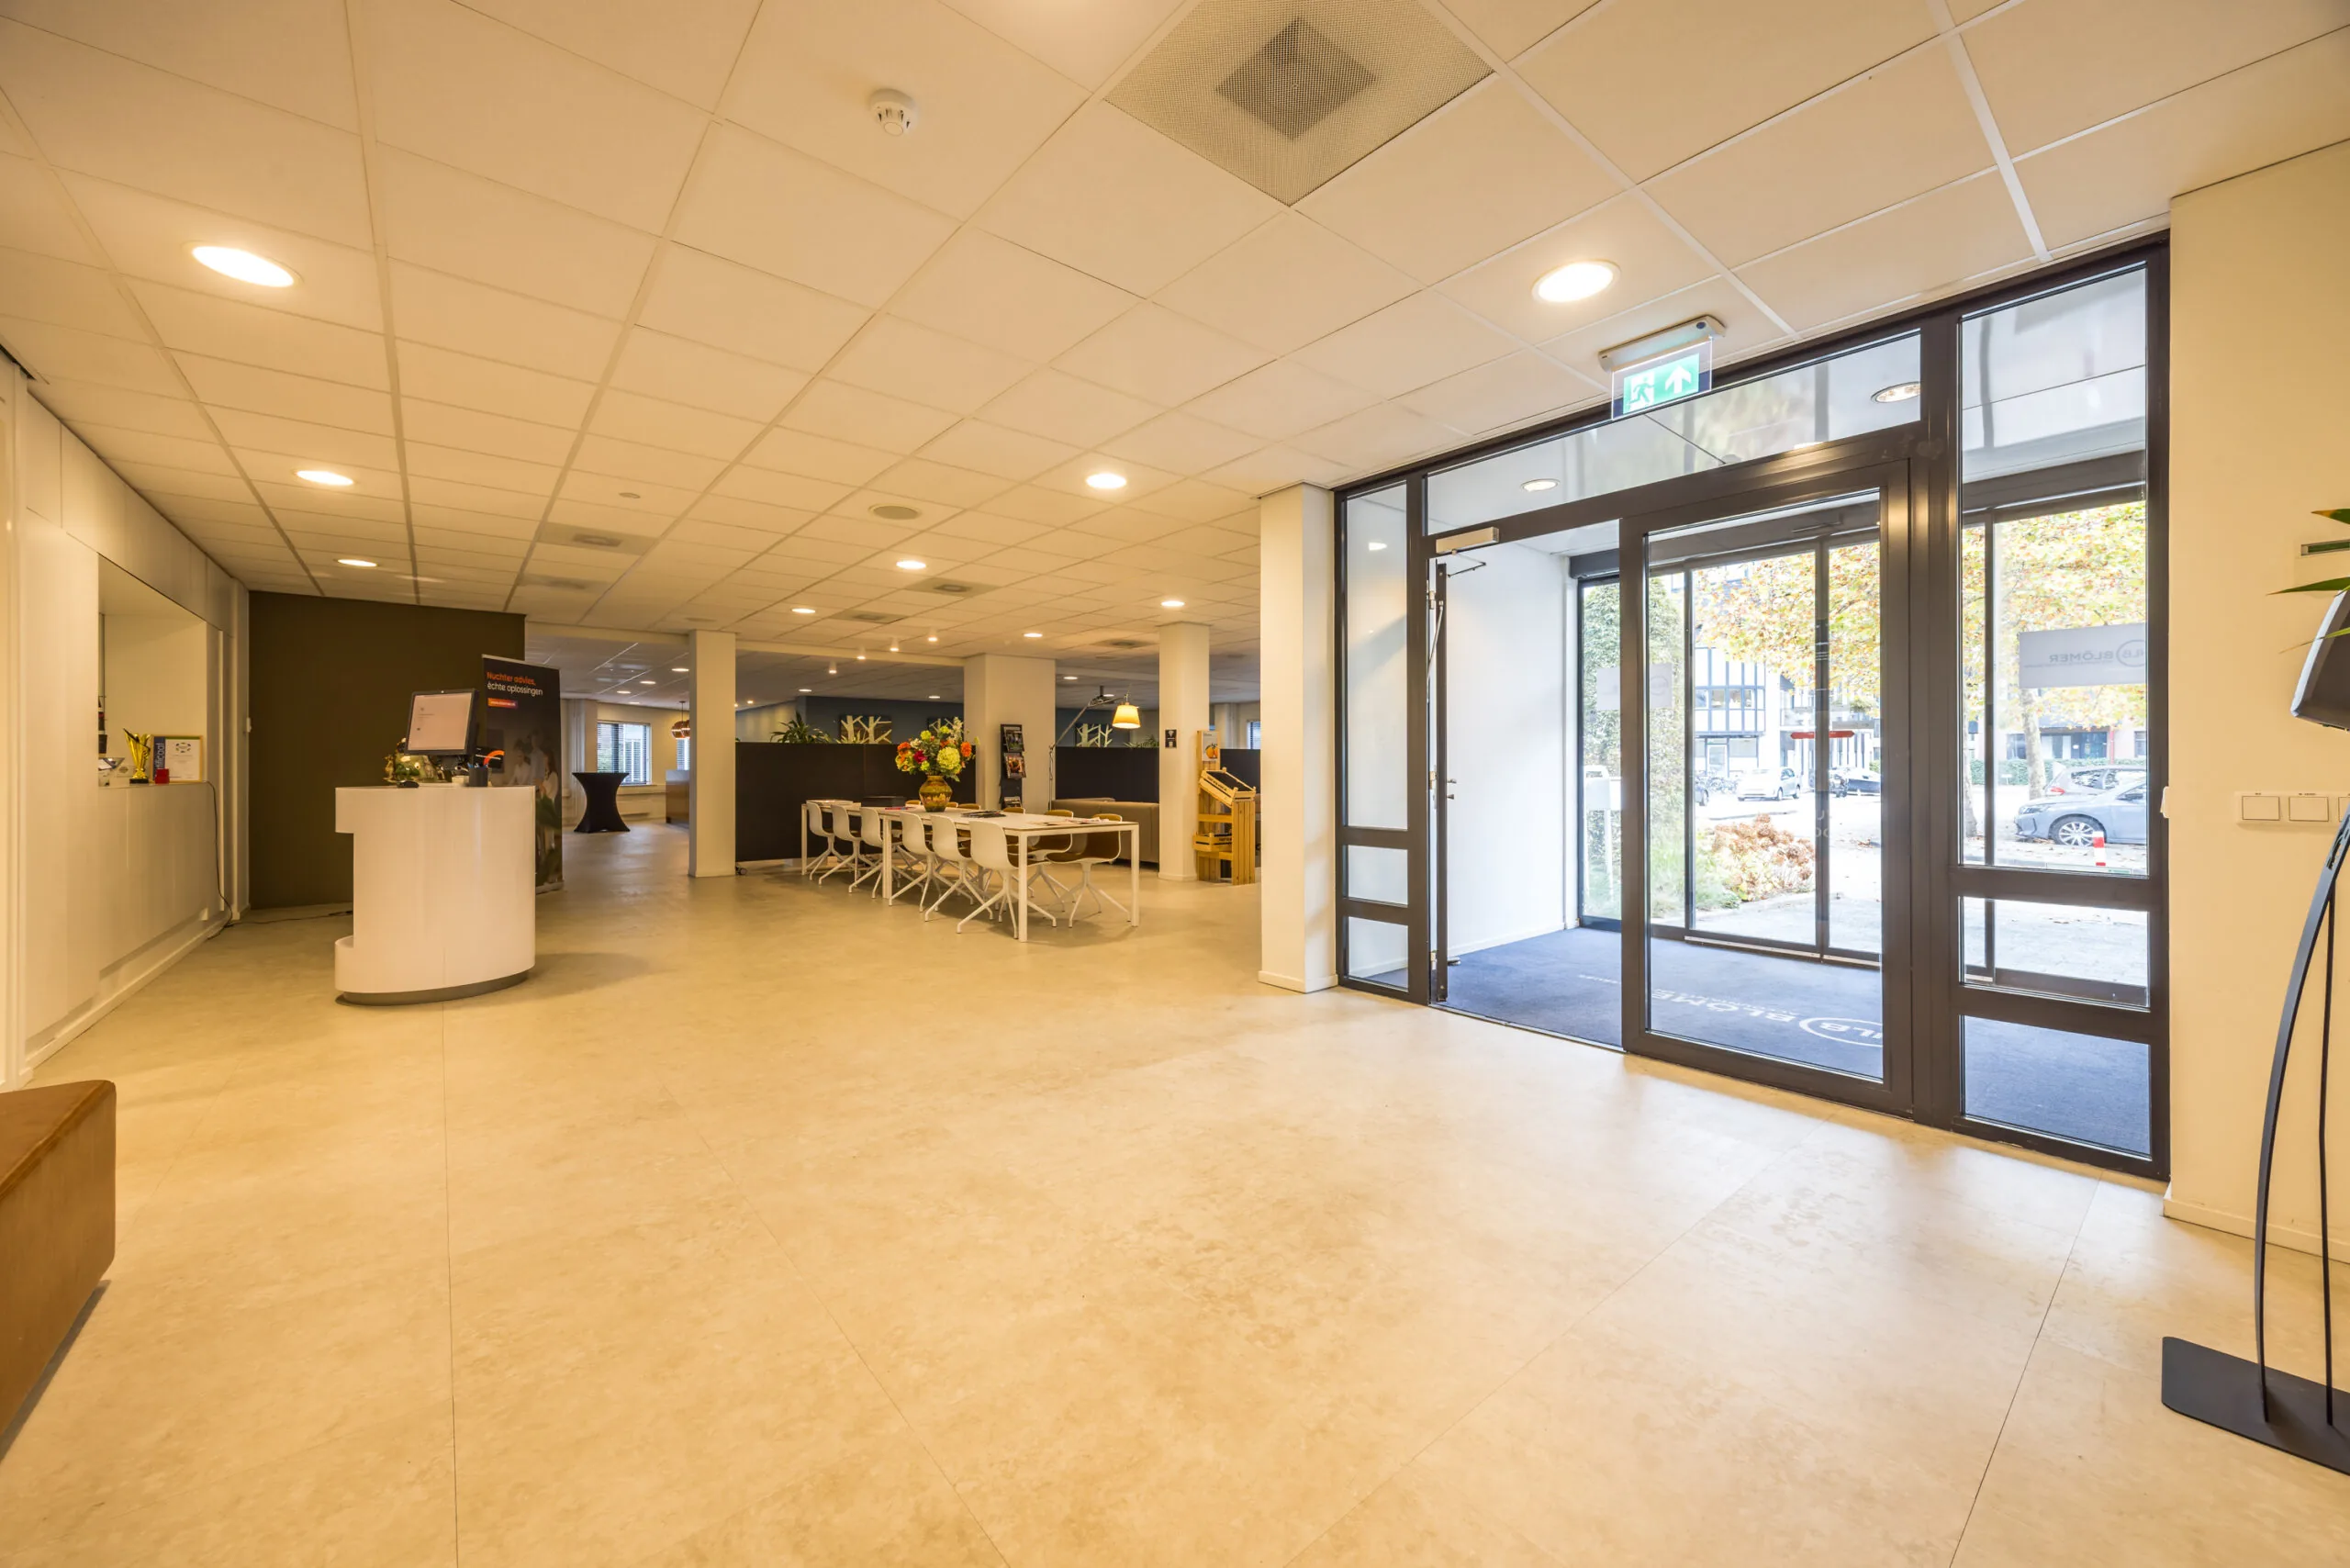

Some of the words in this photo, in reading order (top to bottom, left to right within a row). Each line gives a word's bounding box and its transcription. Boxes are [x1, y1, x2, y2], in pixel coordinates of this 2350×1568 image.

[487, 671, 513, 681] Nuchter
[507, 685, 543, 697] oplossingen
[1651, 988, 1796, 1023] BLÖME
